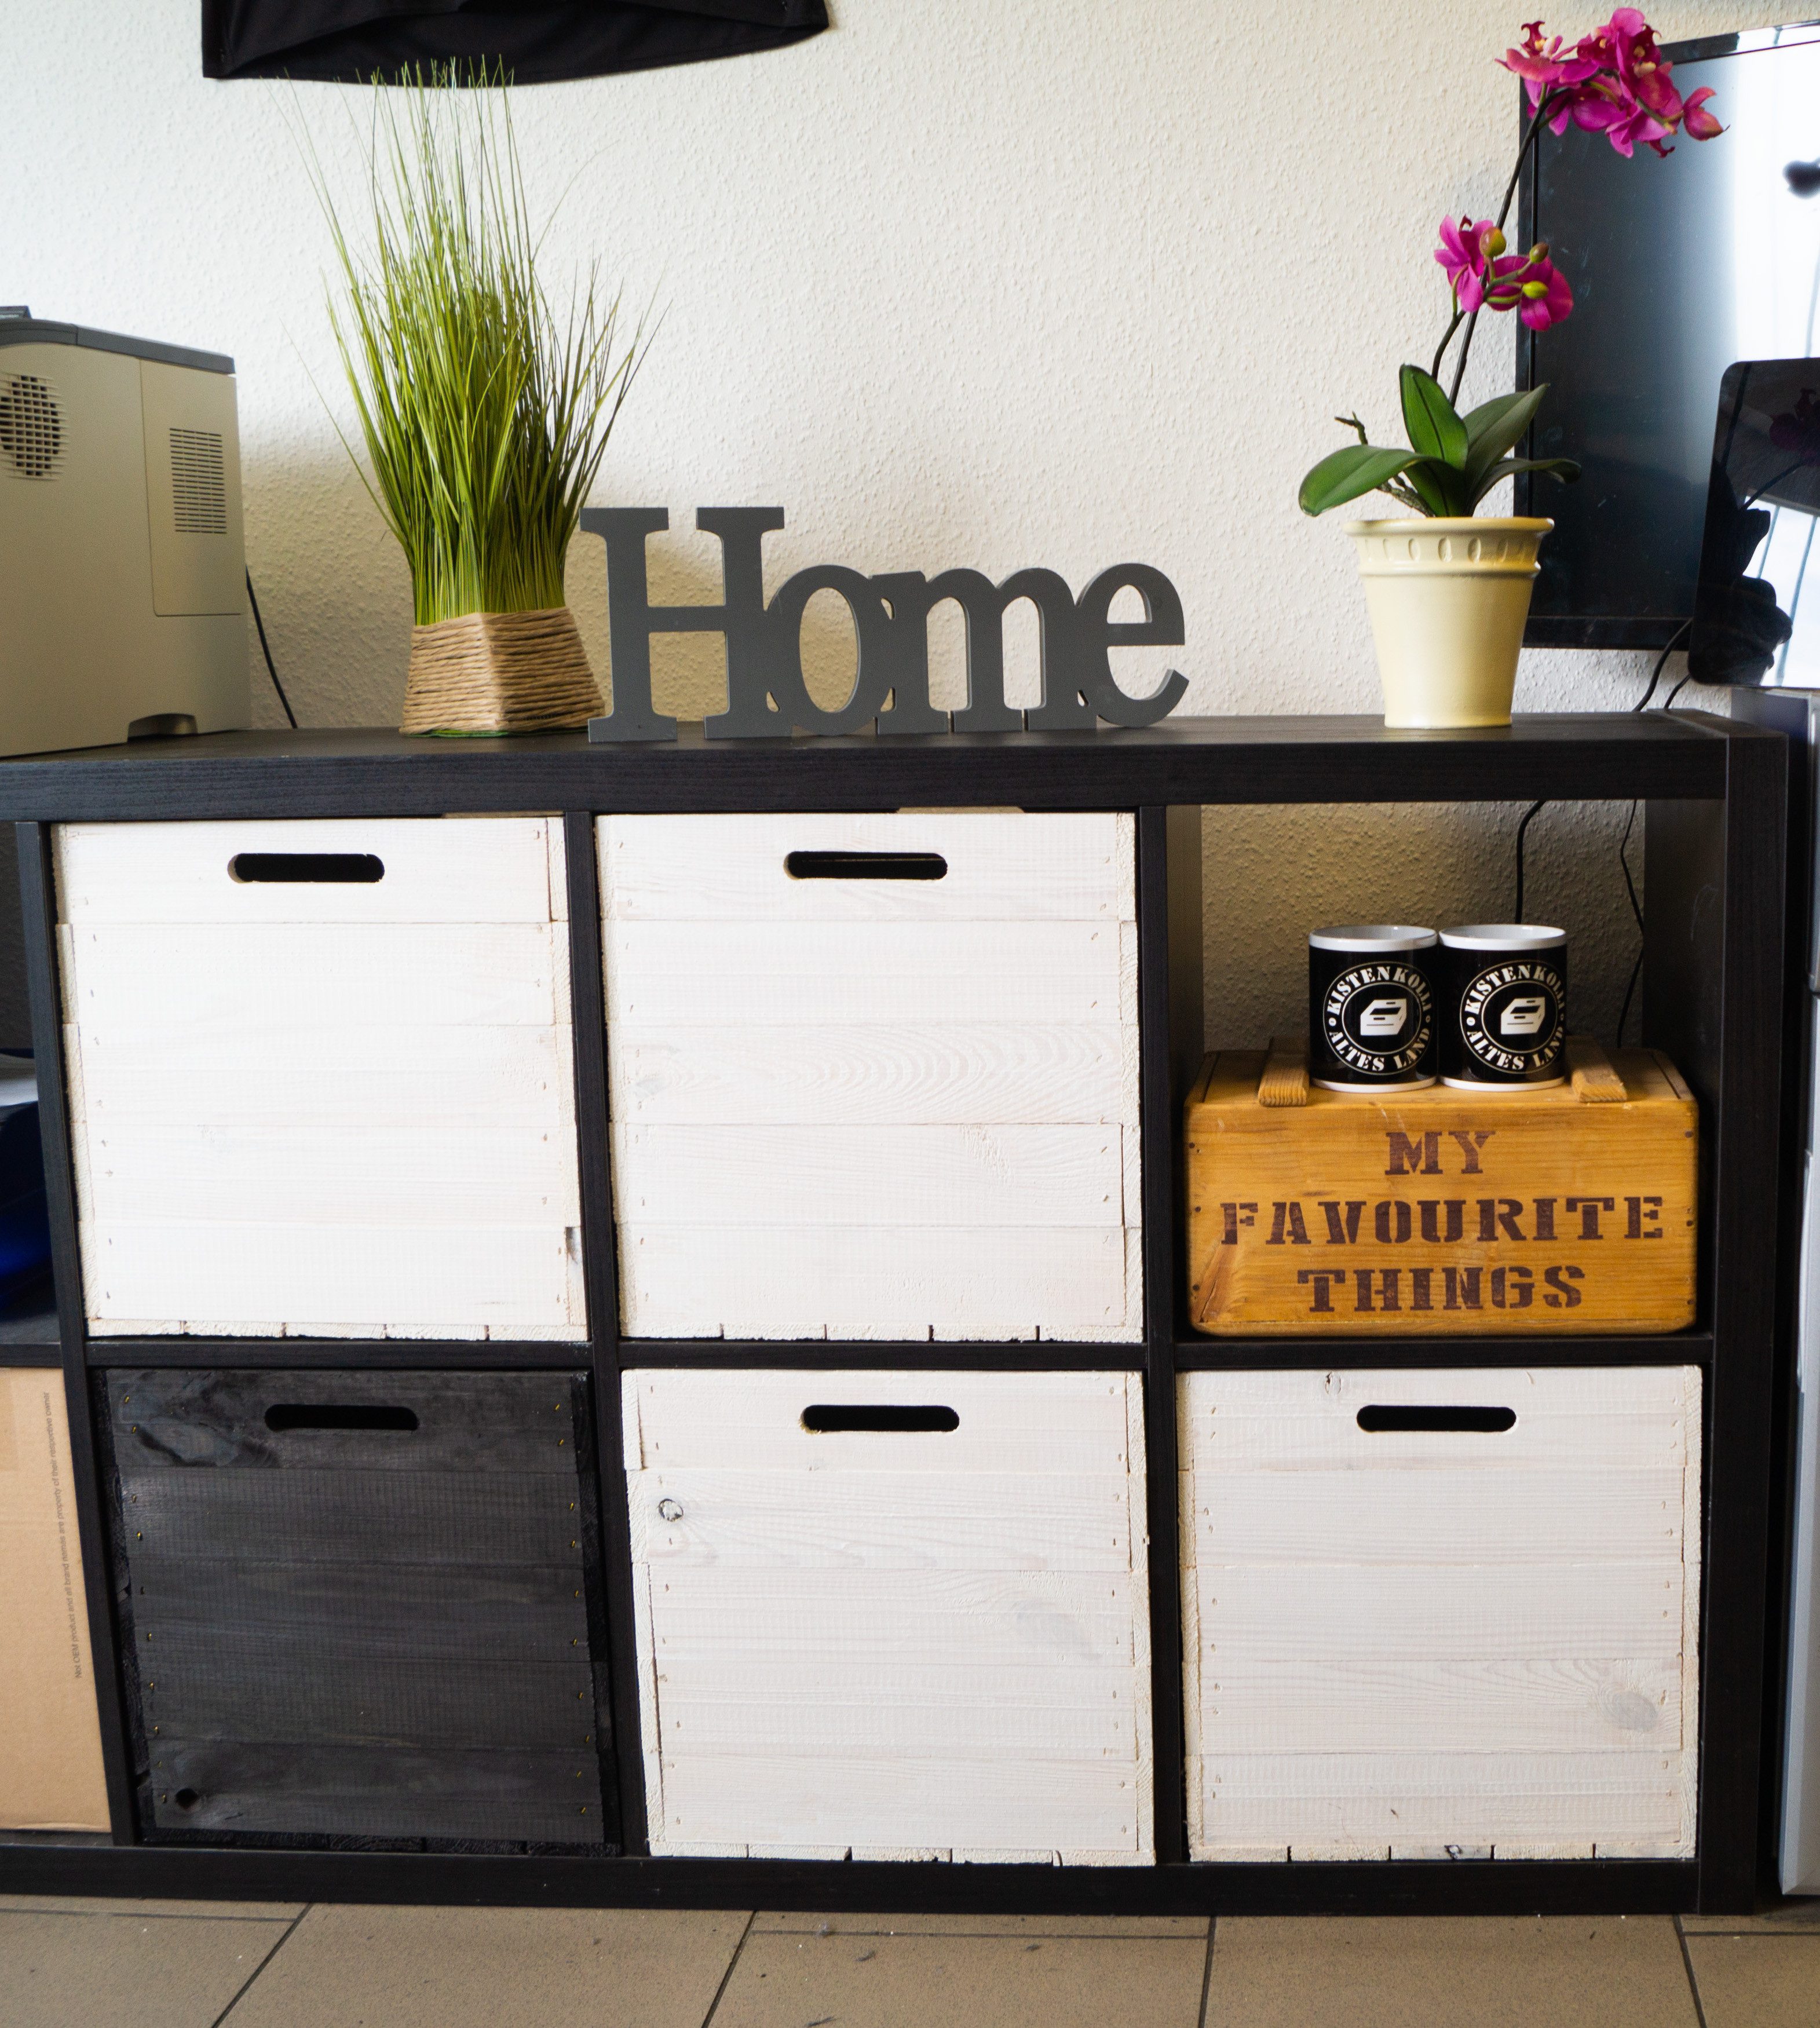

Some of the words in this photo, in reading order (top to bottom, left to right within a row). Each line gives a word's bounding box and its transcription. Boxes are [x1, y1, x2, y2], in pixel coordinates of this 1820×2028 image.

[579, 506, 1189, 743] Home
[1329, 1032, 1384, 1072] ALTES
[1393, 1028, 1430, 1069] LAND
[1467, 1031, 1525, 1070] ALTES
[1532, 1026, 1563, 1068] LAND
[1384, 1130, 1496, 1175] MY
[1220, 1196, 1663, 1246] FAVOURITE
[1297, 1265, 1585, 1313] THINGS
[46, 1418, 57, 1457] respective
[50, 1459, 59, 1477] their
[52, 1478, 60, 1486] of
[54, 1488, 65, 1519] property
[60, 1536, 68, 1562] names
[62, 1563, 72, 1585] brand
[66, 1598, 74, 1612] and
[68, 1614, 80, 1642] product
[71, 1644, 81, 1663] OEM
[74, 1665, 82, 1679] Not
